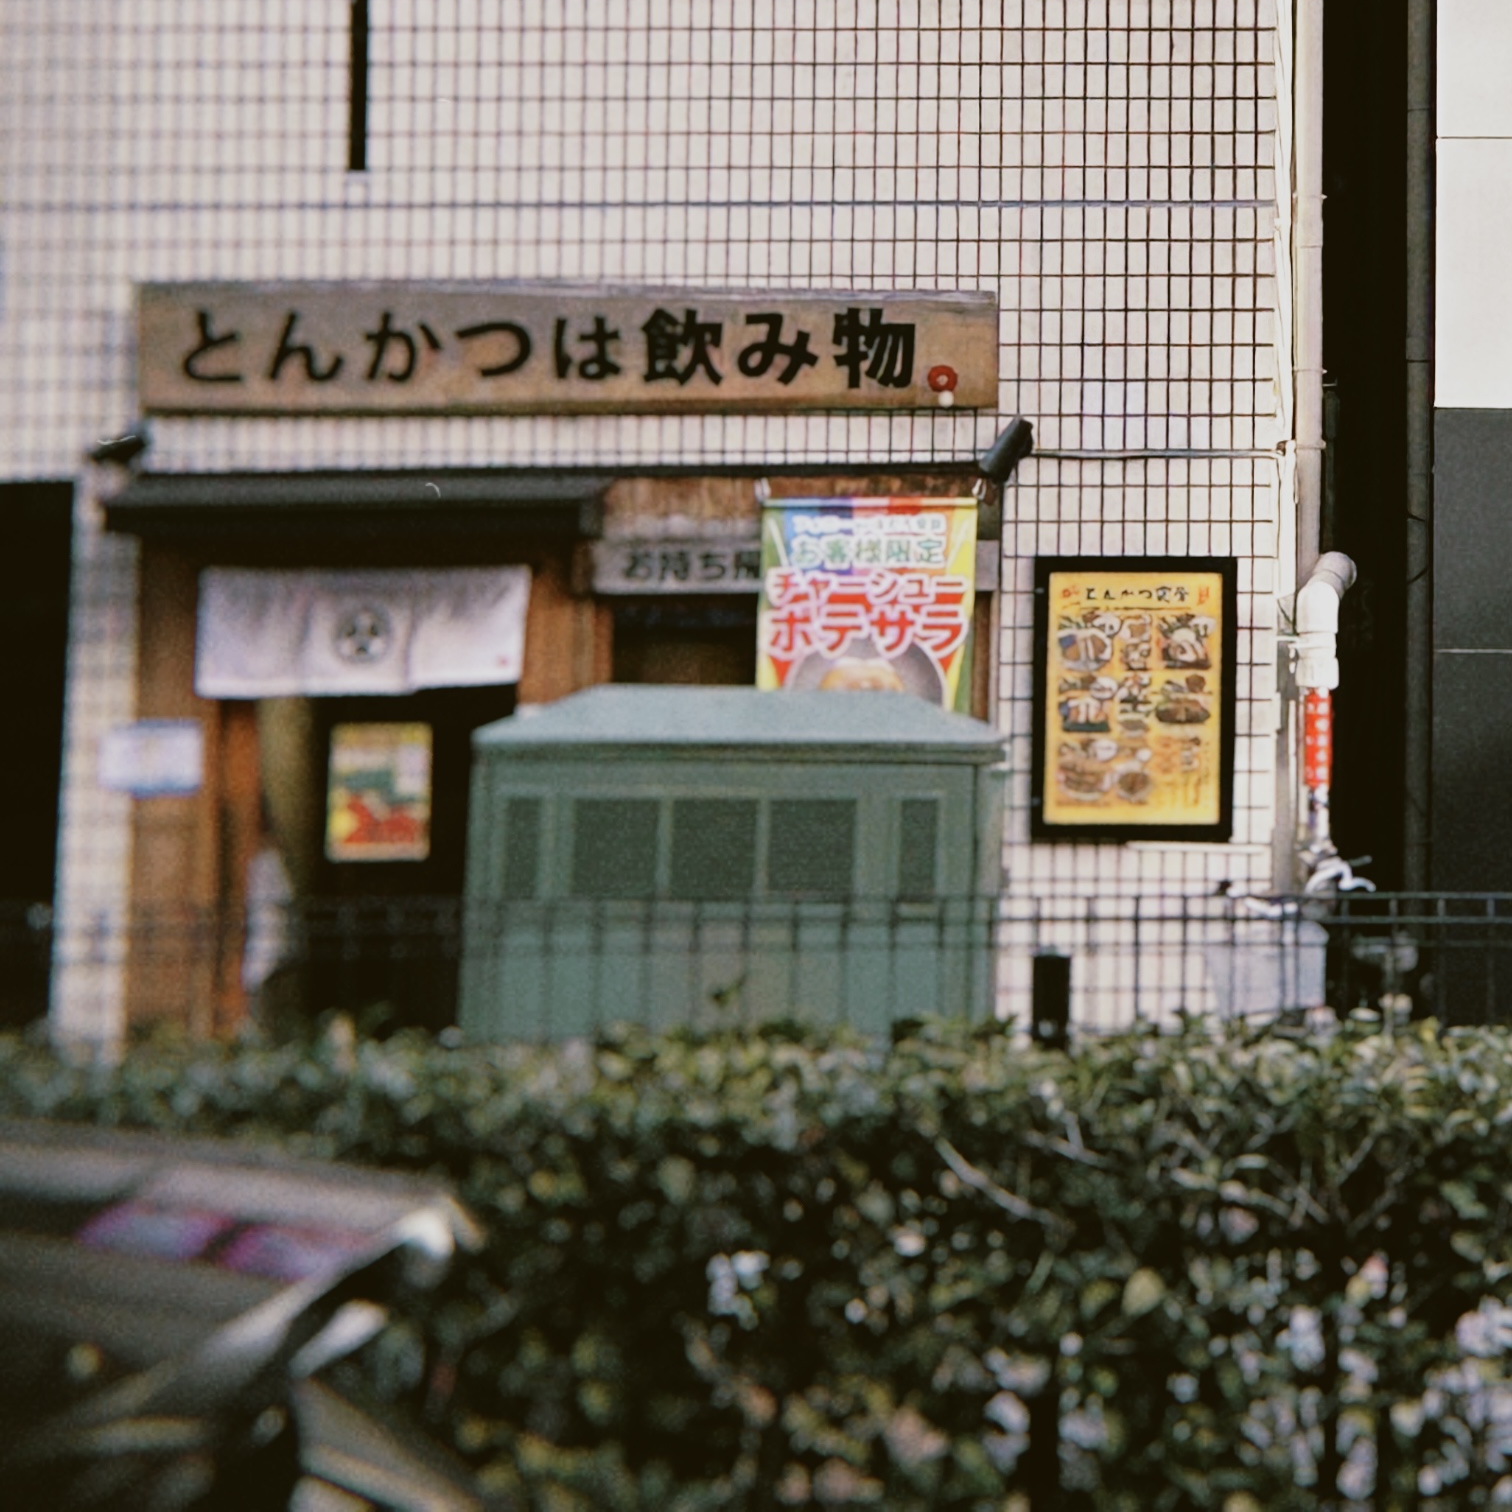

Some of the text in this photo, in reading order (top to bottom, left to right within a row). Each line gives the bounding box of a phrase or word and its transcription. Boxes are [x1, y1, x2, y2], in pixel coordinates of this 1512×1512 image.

[182, 306, 916, 389] とんかつは飲み物
[772, 572, 965, 600] チャーシュー
